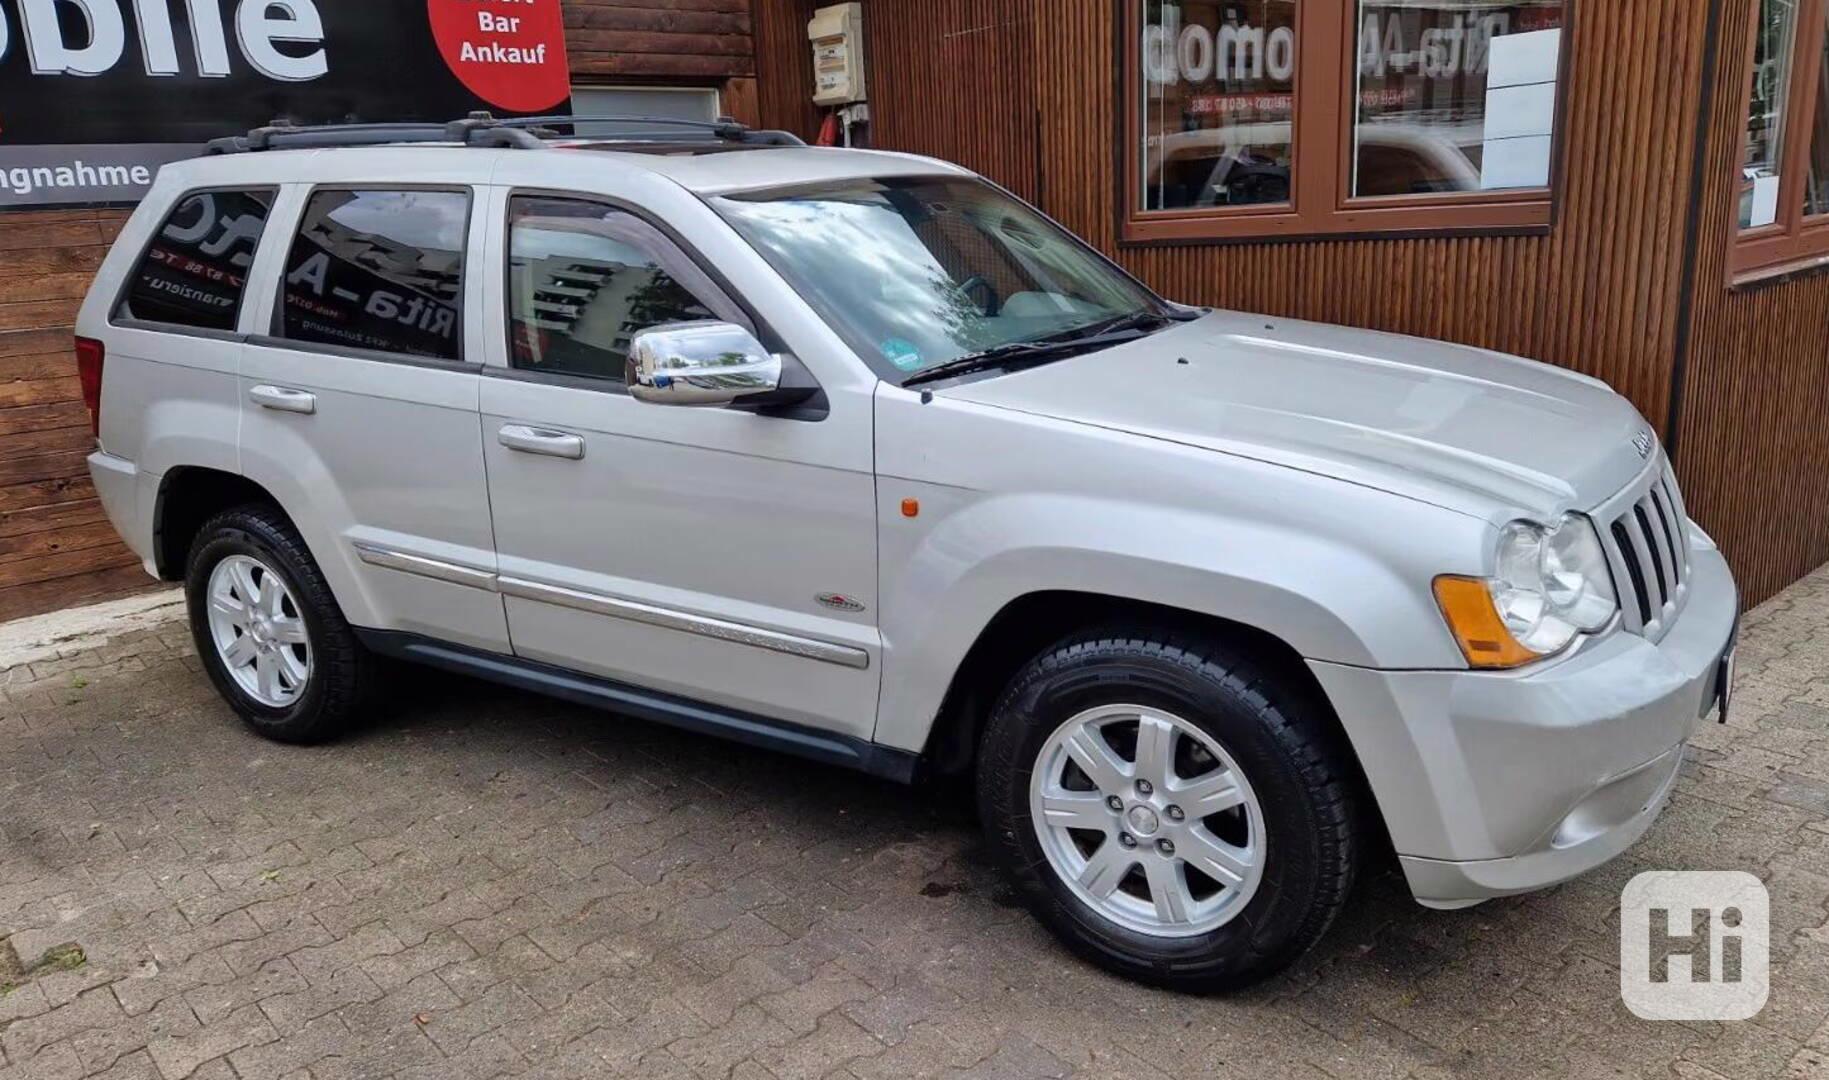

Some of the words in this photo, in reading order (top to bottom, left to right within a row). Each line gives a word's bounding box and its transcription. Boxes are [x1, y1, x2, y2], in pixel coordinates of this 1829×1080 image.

[478, 11, 520, 32] Bar
[0, 0, 328, 81] bile
[460, 41, 545, 64] Ankauf
